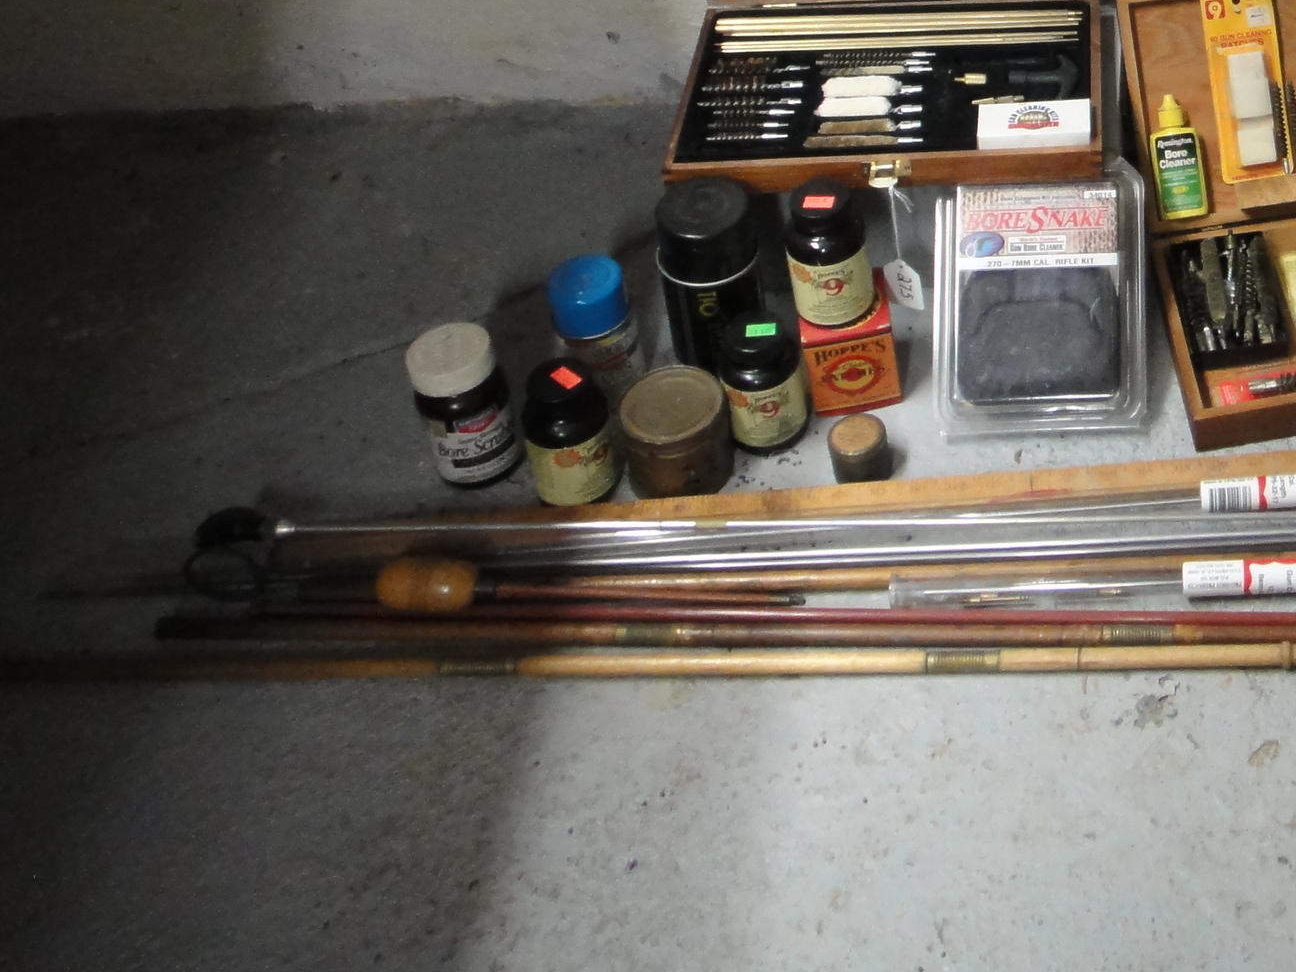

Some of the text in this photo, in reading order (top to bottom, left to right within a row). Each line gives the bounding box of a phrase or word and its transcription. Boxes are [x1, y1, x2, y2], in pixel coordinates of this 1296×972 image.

[1237, 29, 1272, 39] CLEANING
[1164, 149, 1188, 159] Bore
[1159, 157, 1196, 169] Cleaner
[1011, 259, 1031, 267] 7MM
[822, 277, 844, 296] 9
[813, 338, 887, 366] HOPPE'S
[437, 443, 470, 457] Bore
